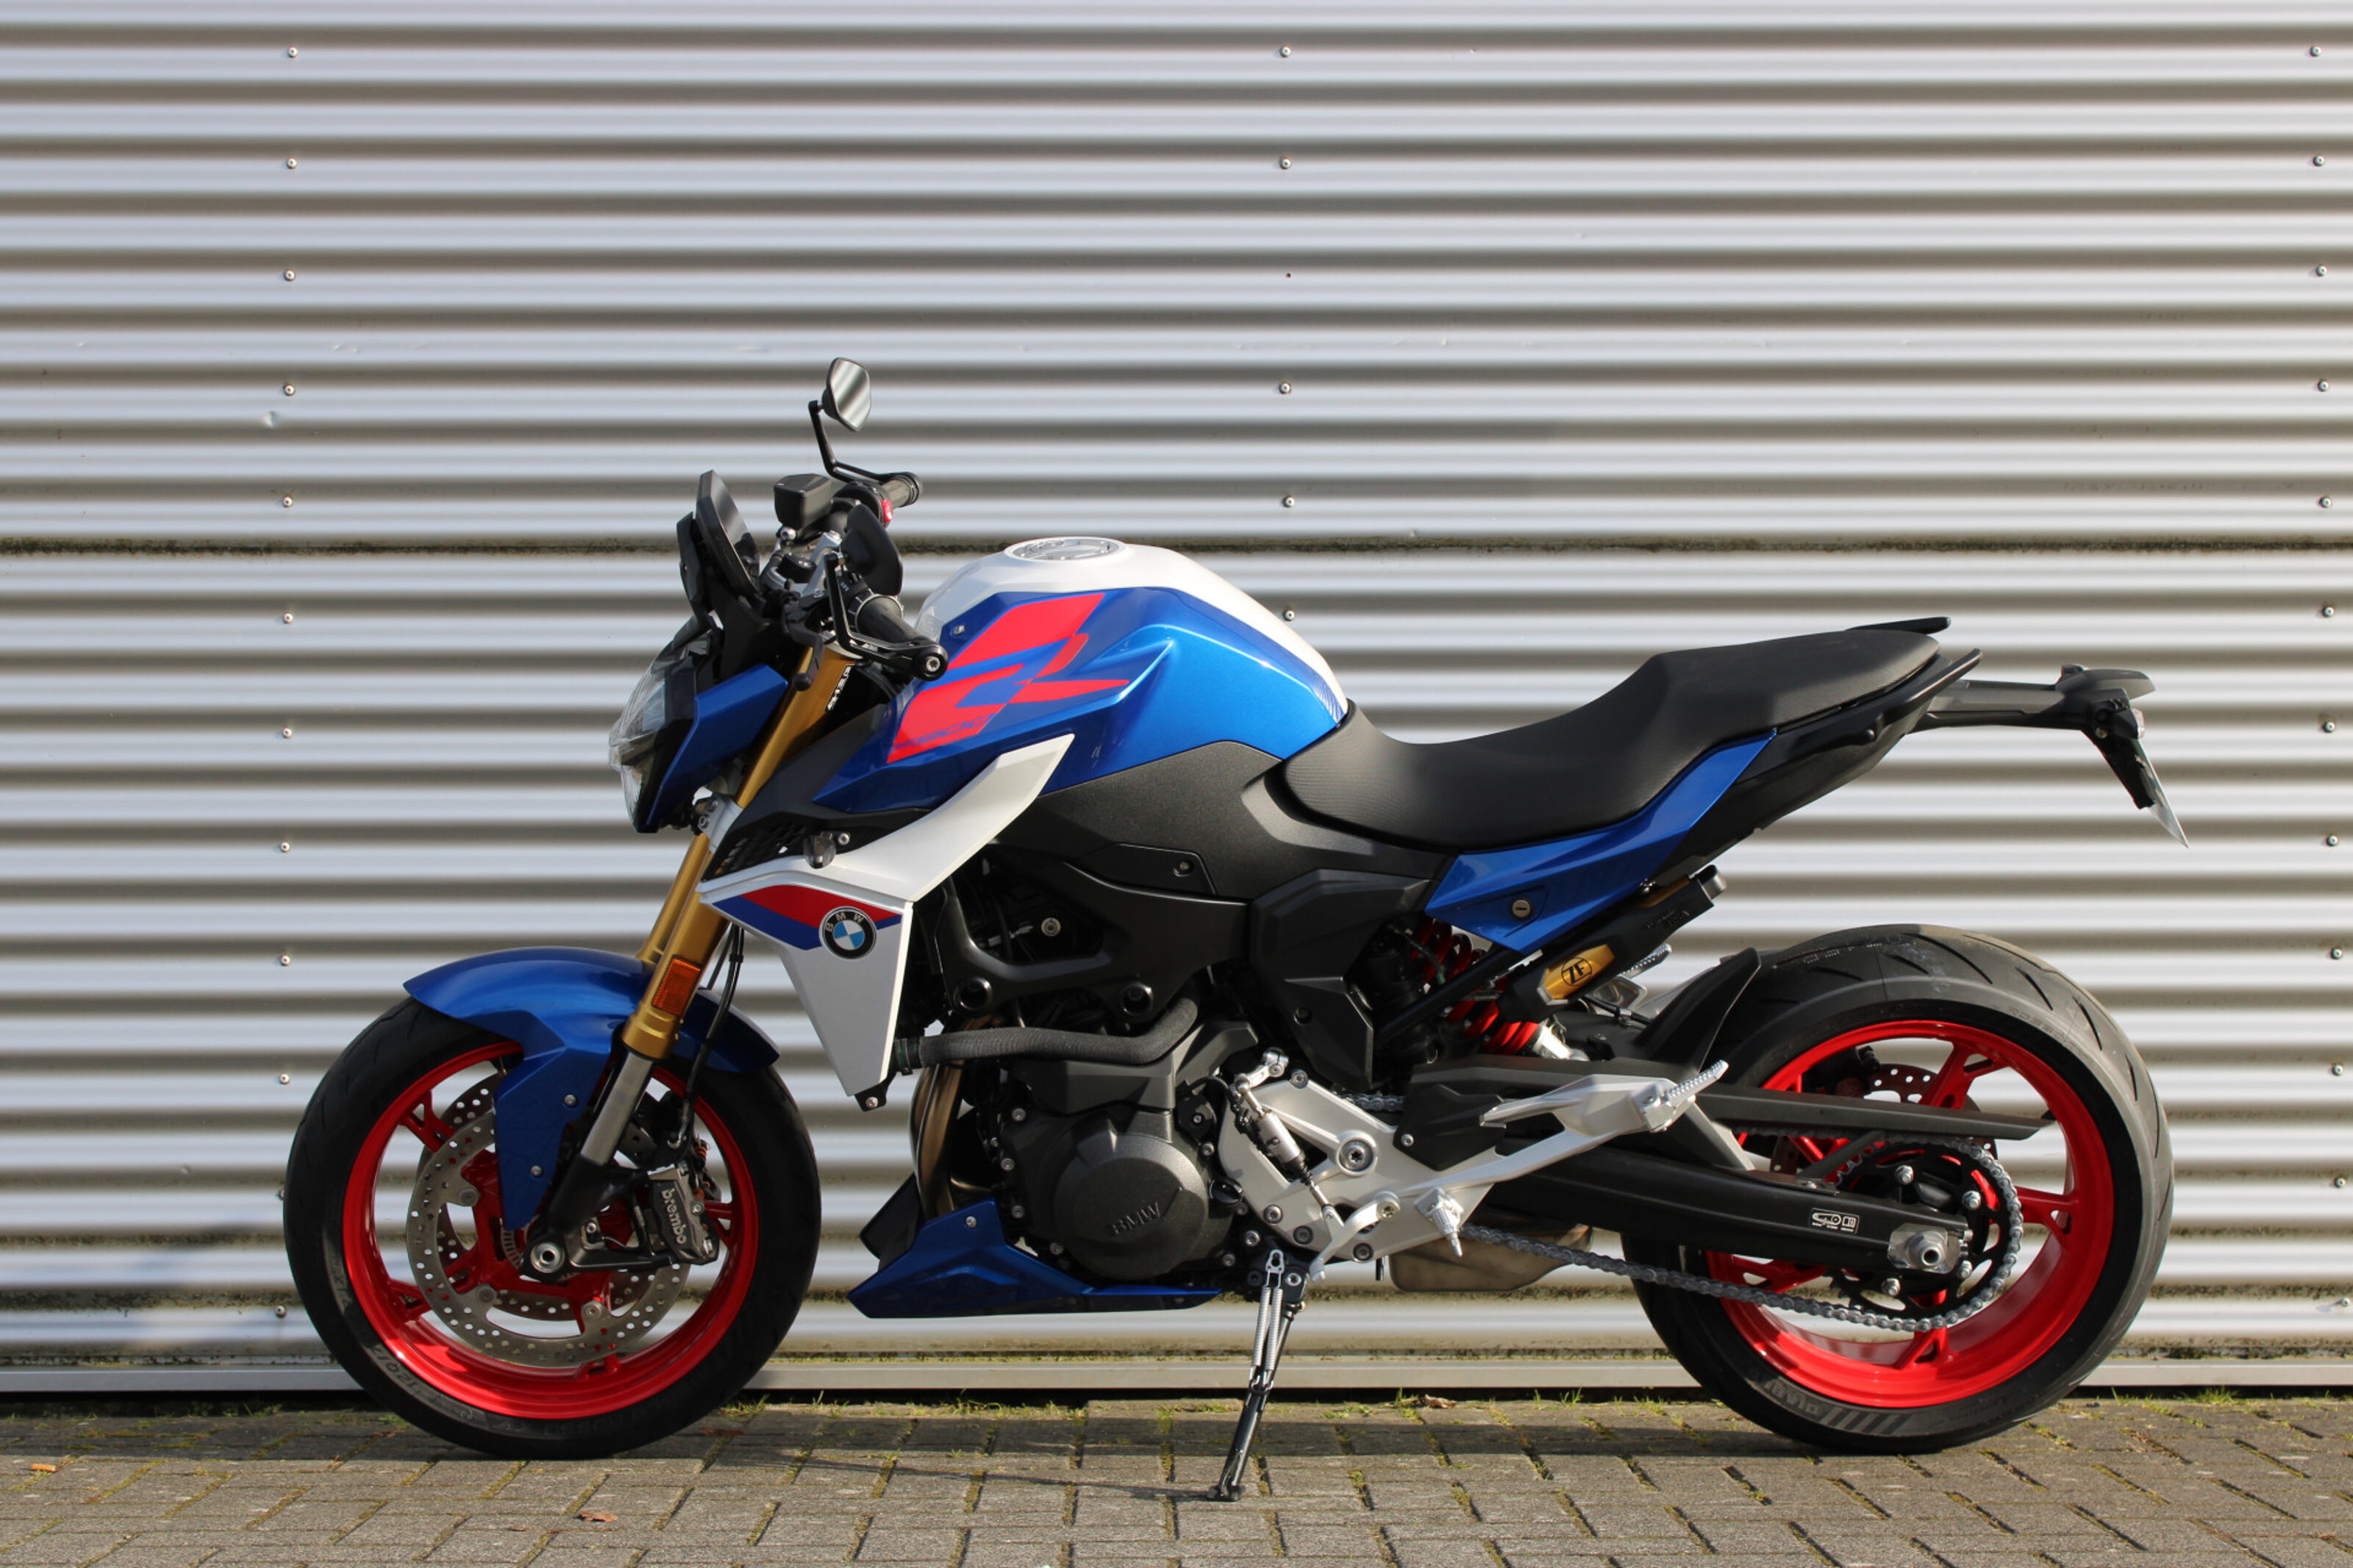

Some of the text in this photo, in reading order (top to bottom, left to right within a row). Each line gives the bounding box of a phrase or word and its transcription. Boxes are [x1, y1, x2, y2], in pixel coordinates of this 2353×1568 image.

[825, 912, 865, 932] BMW
[1563, 959, 1591, 984] ZF
[661, 1188, 687, 1244] brembo
[1111, 1201, 1160, 1234] BMW
